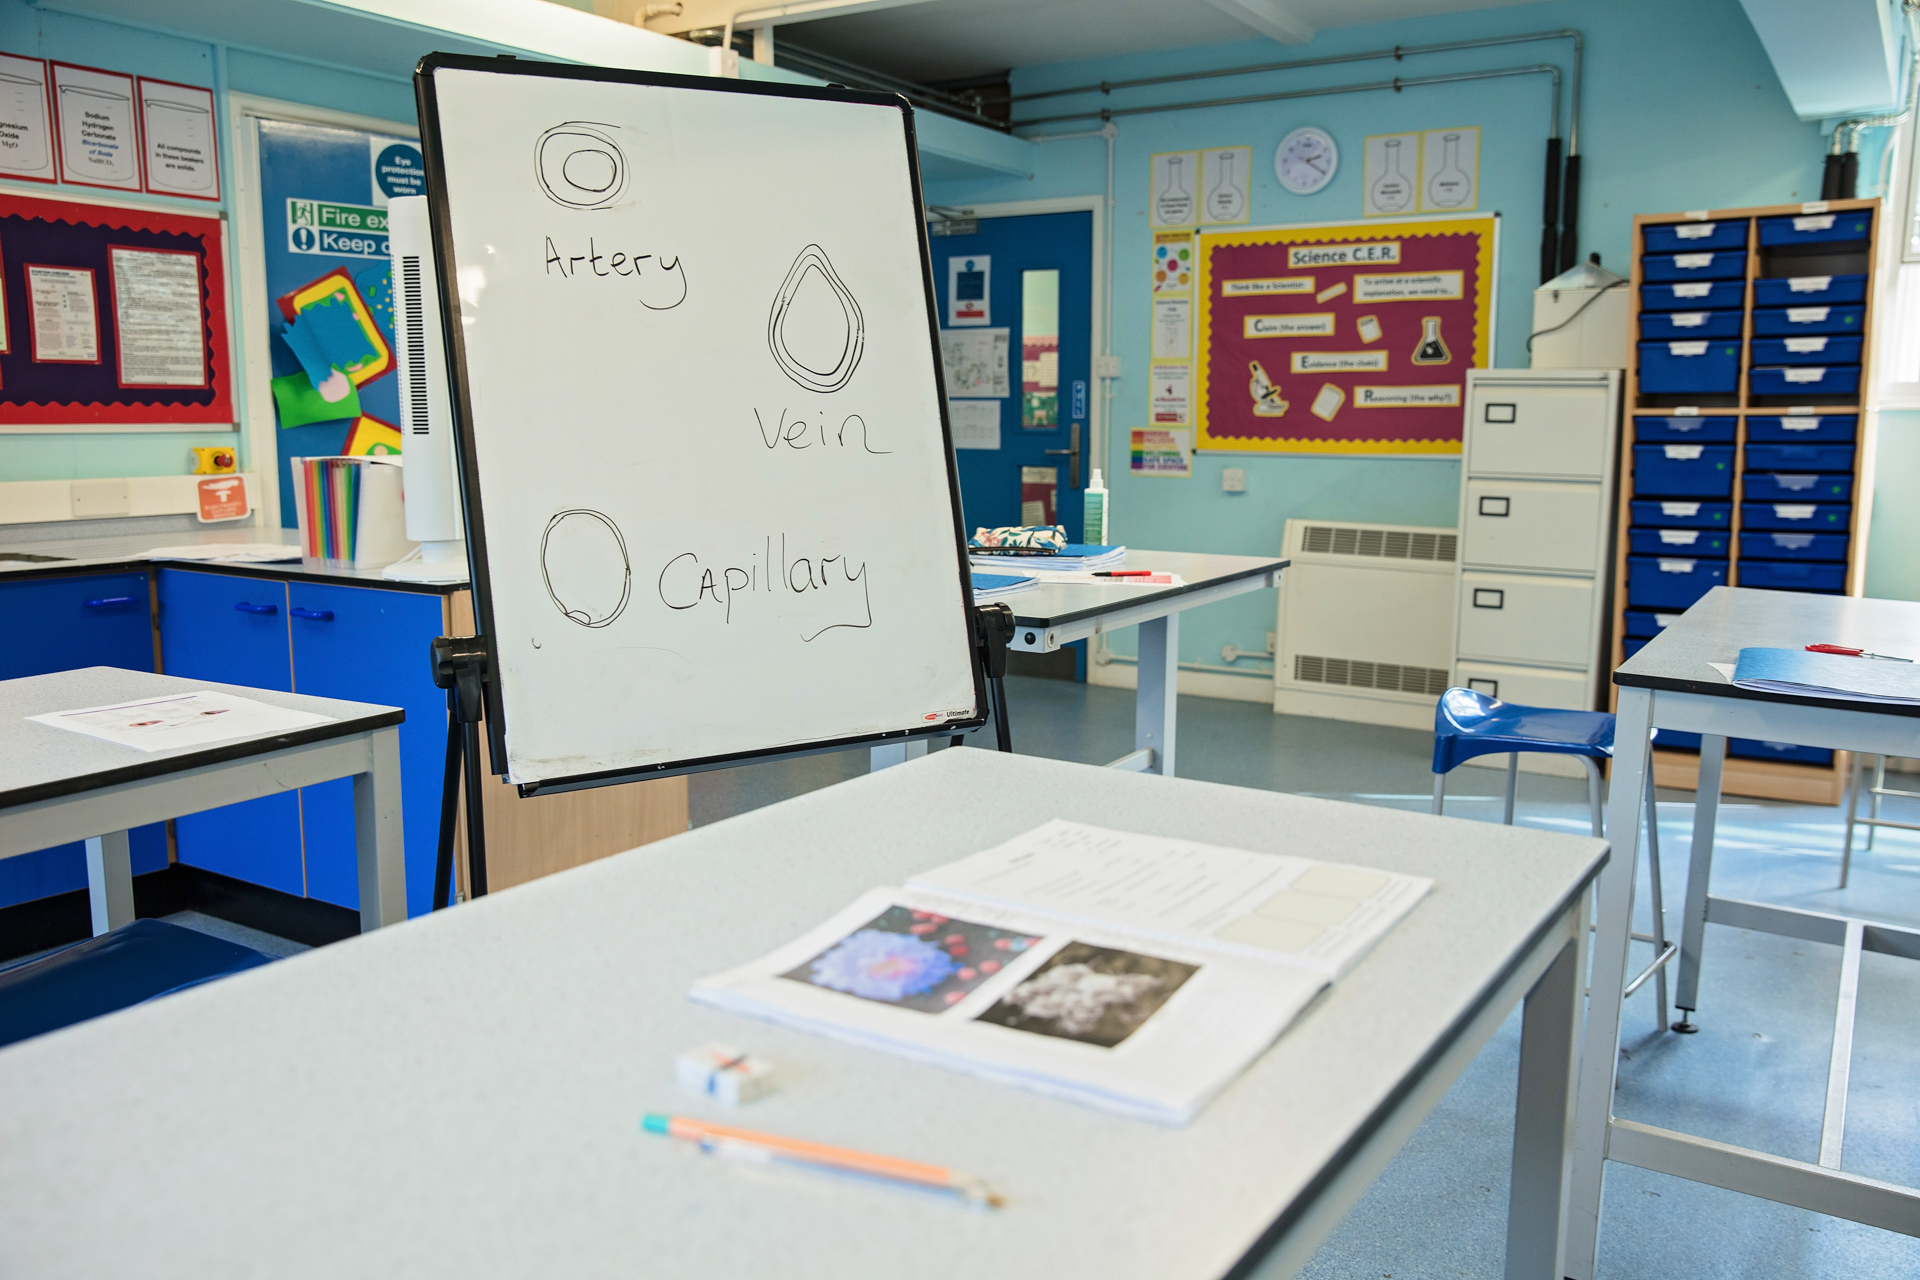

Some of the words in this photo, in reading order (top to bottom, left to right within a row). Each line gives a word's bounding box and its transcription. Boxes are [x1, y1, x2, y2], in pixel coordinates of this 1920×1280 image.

[84, 111, 111, 121] Sodium
[81, 120, 115, 131] Hydrogen
[81, 130, 117, 141] Carbonate
[82, 139, 119, 150] Bicarbonate
[97, 150, 114, 158] Soda
[166, 146, 202, 155] compounds
[180, 155, 205, 165] beakers
[394, 156, 412, 167] Eye
[387, 176, 409, 185] must
[410, 177, 422, 186] be
[393, 186, 417, 195] worn
[321, 207, 361, 227] Fire
[322, 232, 376, 256] Keep
[1292, 250, 1348, 265] Science
[1352, 247, 1397, 262] C.E.R.
[545, 235, 687, 310] Artery
[1230, 283, 1250, 291] Think
[1252, 282, 1265, 291] like
[1254, 319, 1278, 333] Claim
[1279, 323, 1295, 333] (the
[1301, 355, 1338, 370] Evidence
[1363, 389, 1408, 405] Reasoning
[753, 406, 895, 455] Vein
[657, 532, 873, 643] Capillary
[946, 708, 970, 718] Ultimate
